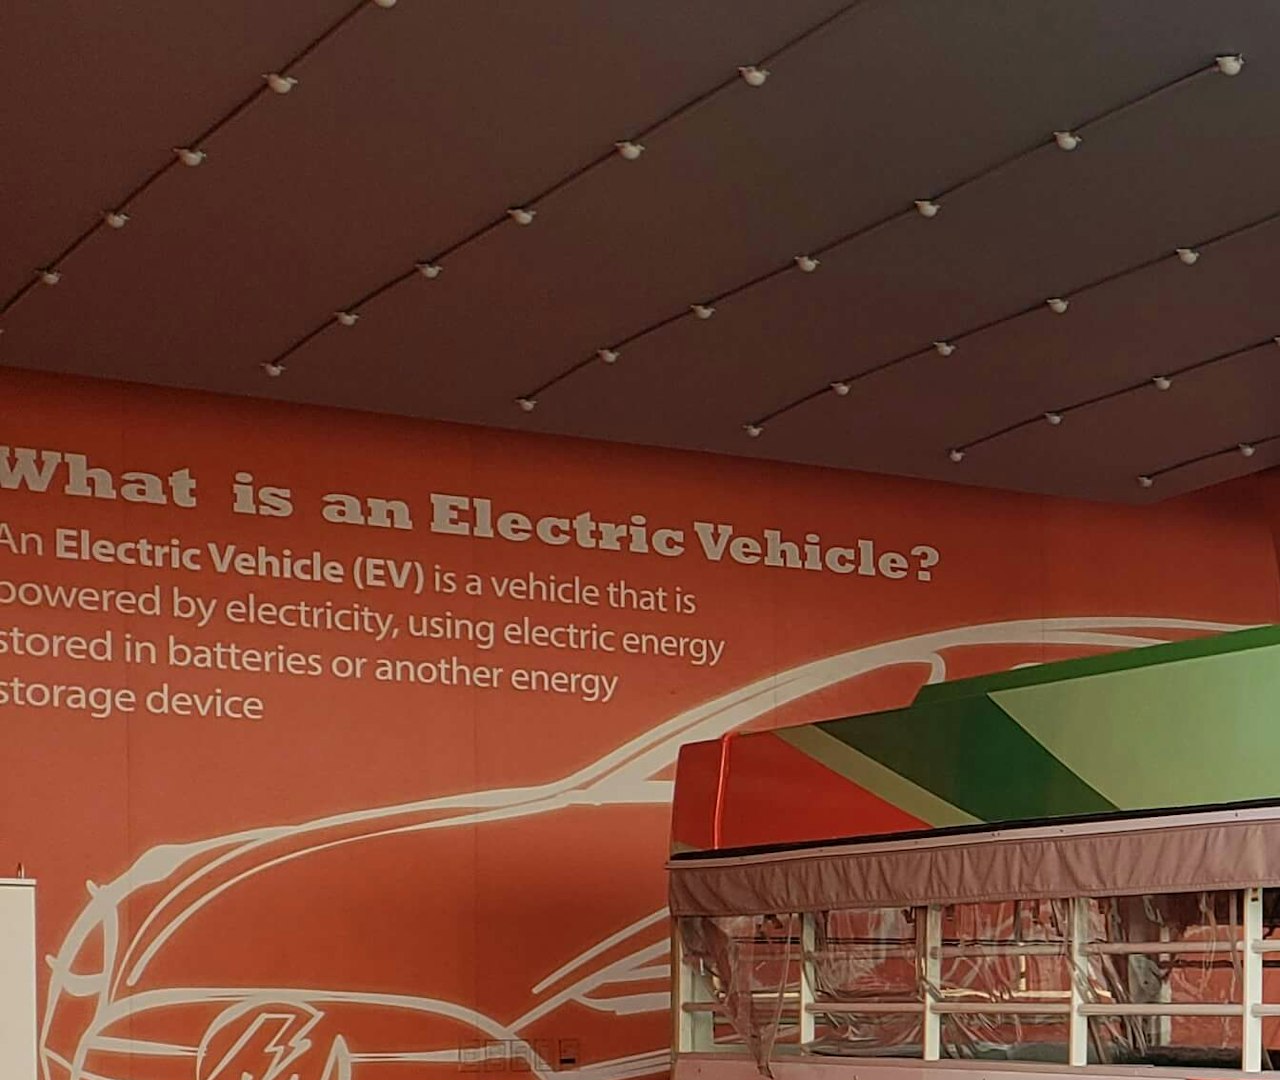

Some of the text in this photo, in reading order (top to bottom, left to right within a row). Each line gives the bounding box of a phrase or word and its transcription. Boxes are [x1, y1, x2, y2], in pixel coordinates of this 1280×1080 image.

[0, 446, 940, 582] What is an Electric Vehicle?
[0, 523, 696, 614] An Electric Vehicle (EV) is a vehicle that is
[0, 580, 725, 667] powered by electricity, using electric energy
[0, 626, 618, 702] stored in batteries or another energy
[0, 676, 264, 720] storage device
